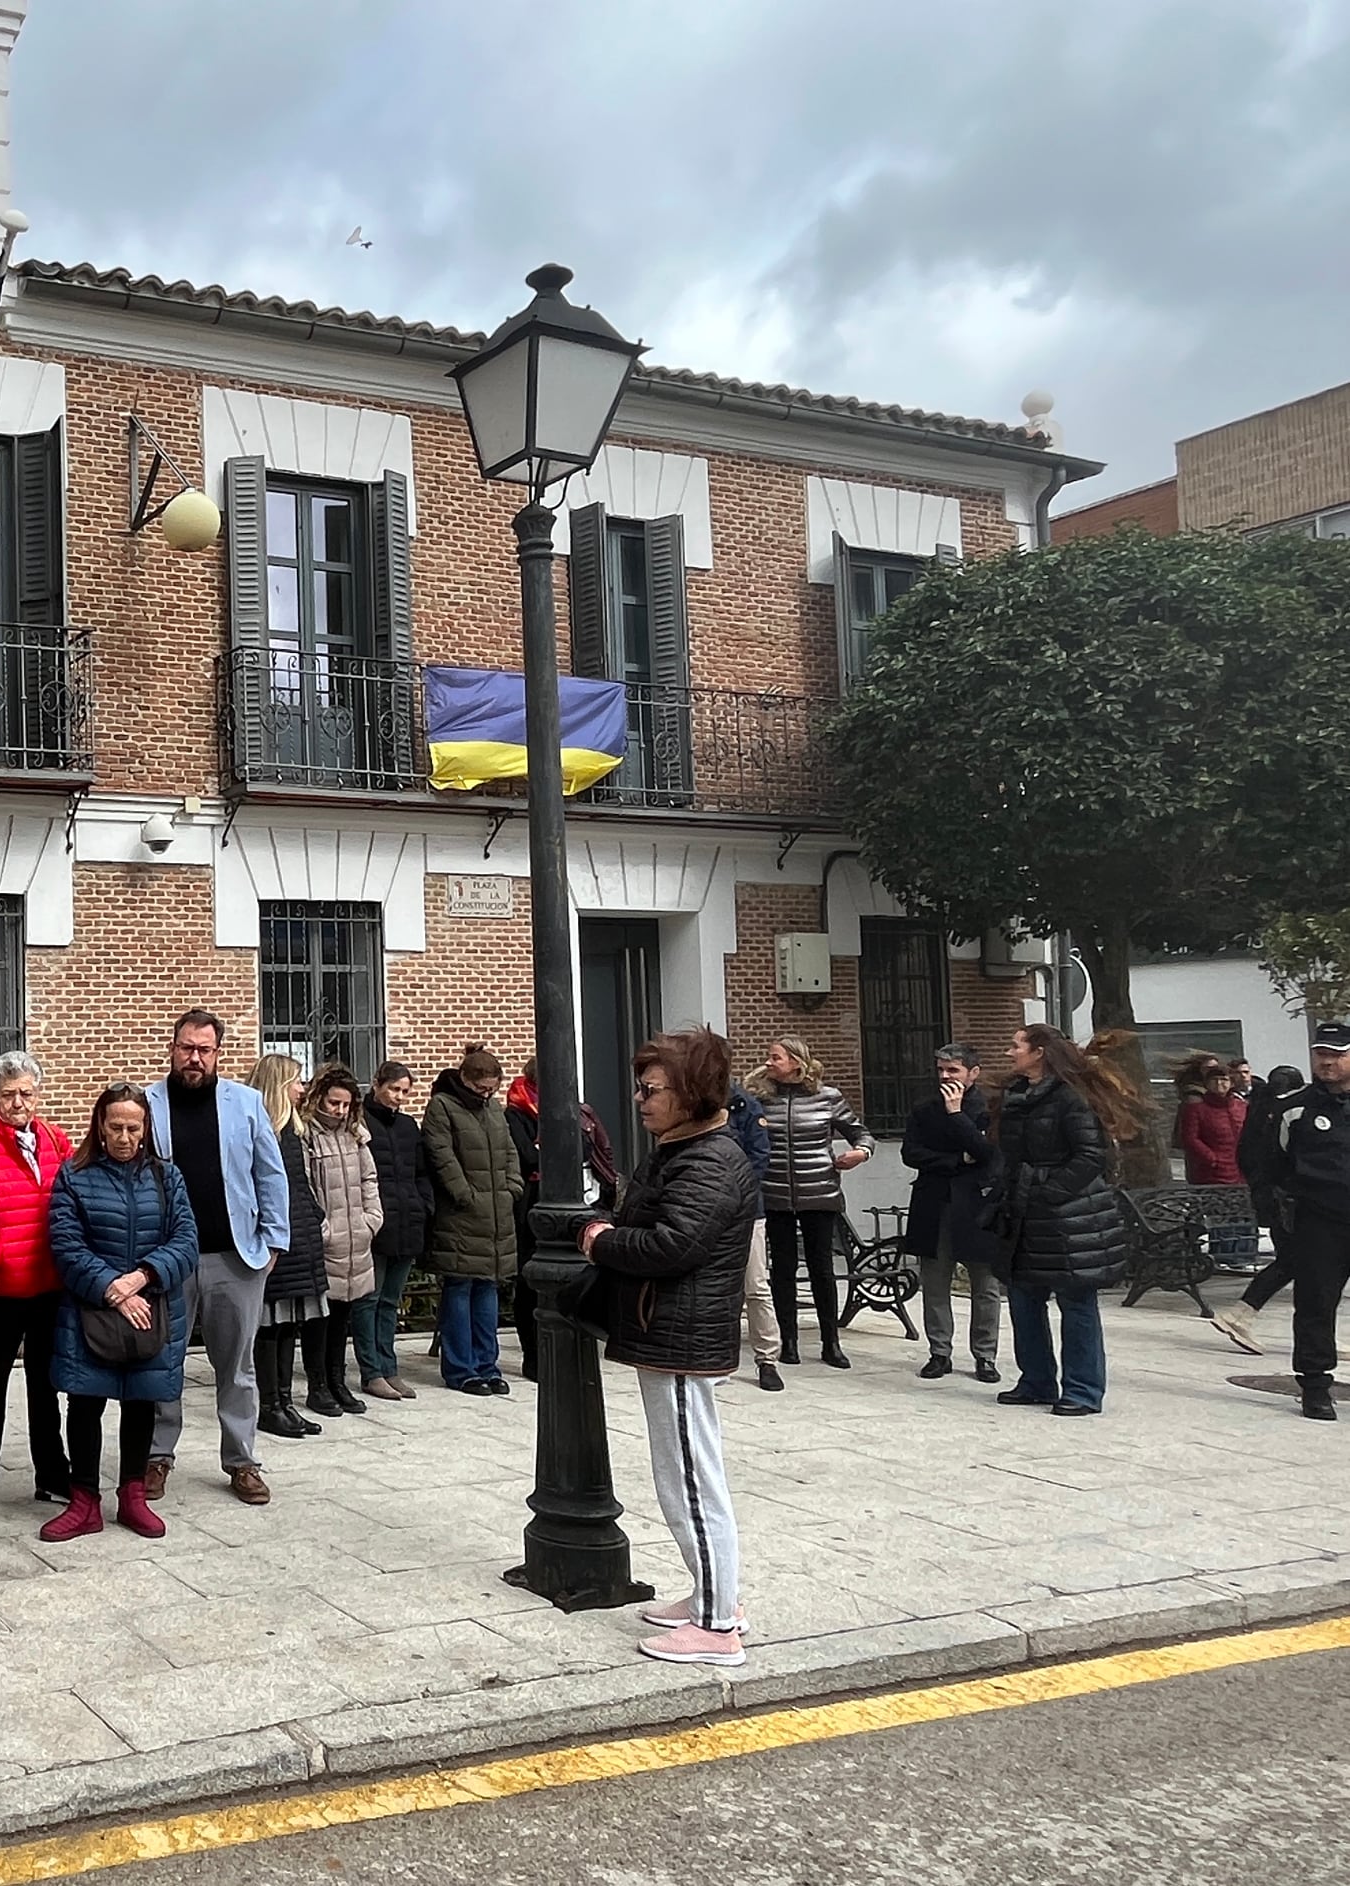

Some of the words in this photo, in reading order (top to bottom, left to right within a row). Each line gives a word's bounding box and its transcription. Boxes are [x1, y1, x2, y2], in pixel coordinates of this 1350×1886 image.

[472, 880, 498, 890] PLAZA
[470, 891, 481, 899] DE
[490, 892, 500, 900] LA
